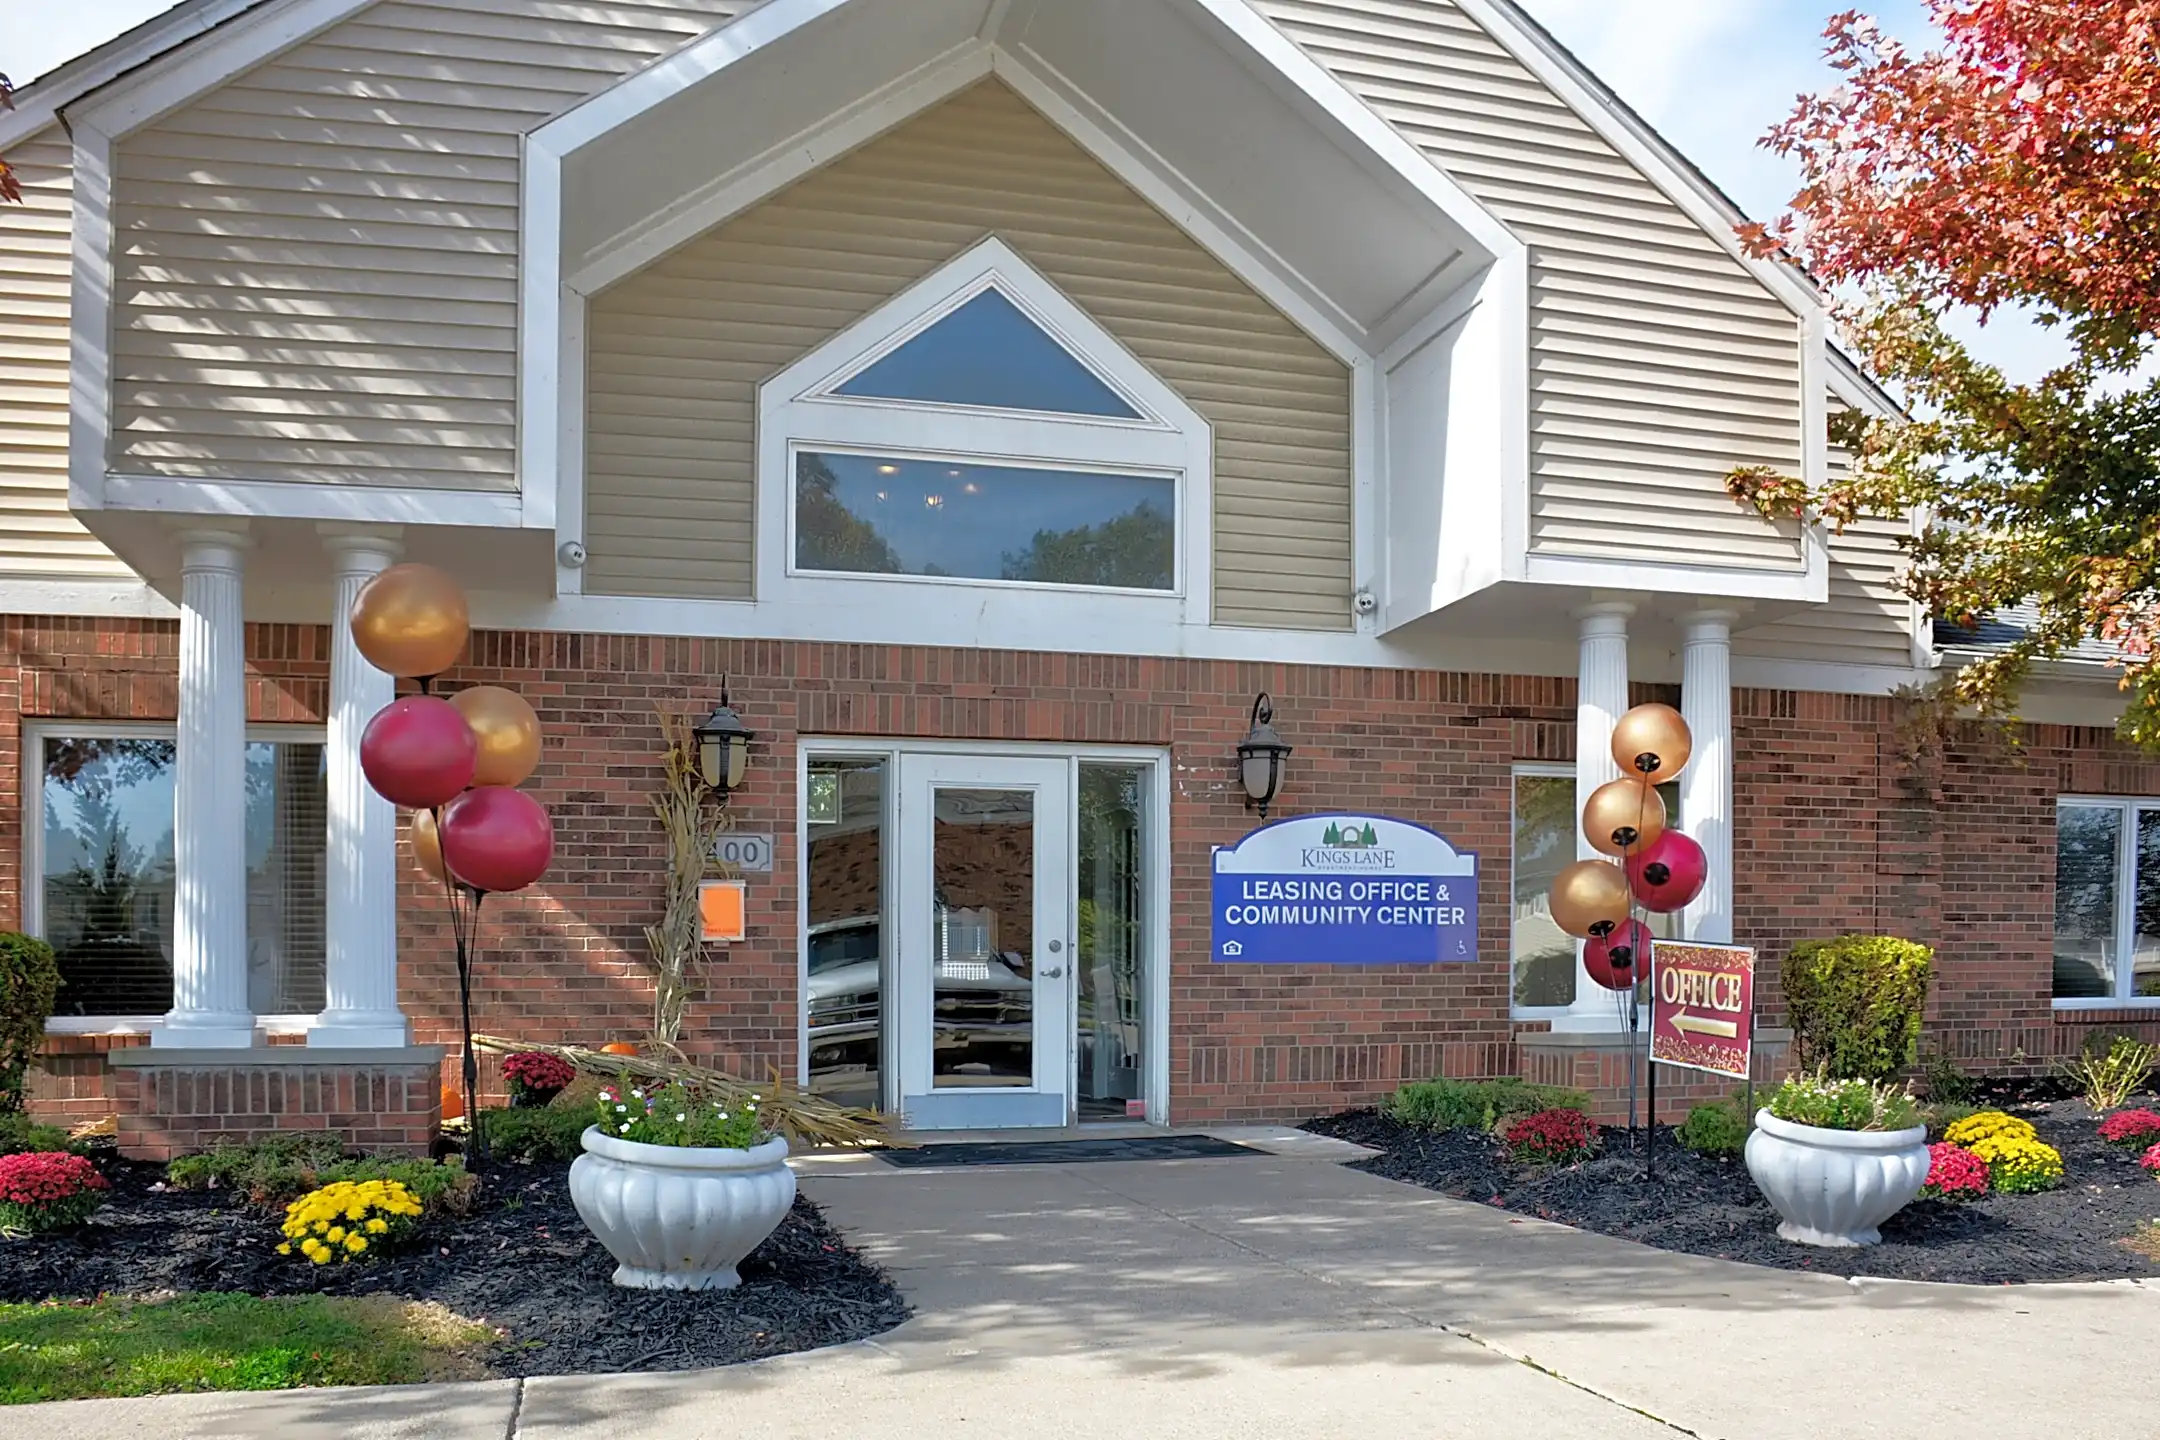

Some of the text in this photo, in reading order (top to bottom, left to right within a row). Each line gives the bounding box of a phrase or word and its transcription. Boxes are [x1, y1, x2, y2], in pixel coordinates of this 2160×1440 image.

[1301, 848, 1395, 869] KINGS LANE
[1243, 881, 1450, 901] LEASING OFFICE &
[1225, 905, 1465, 925] COMMUNITY CENTER
[1661, 966, 1742, 1012] OFFICE
